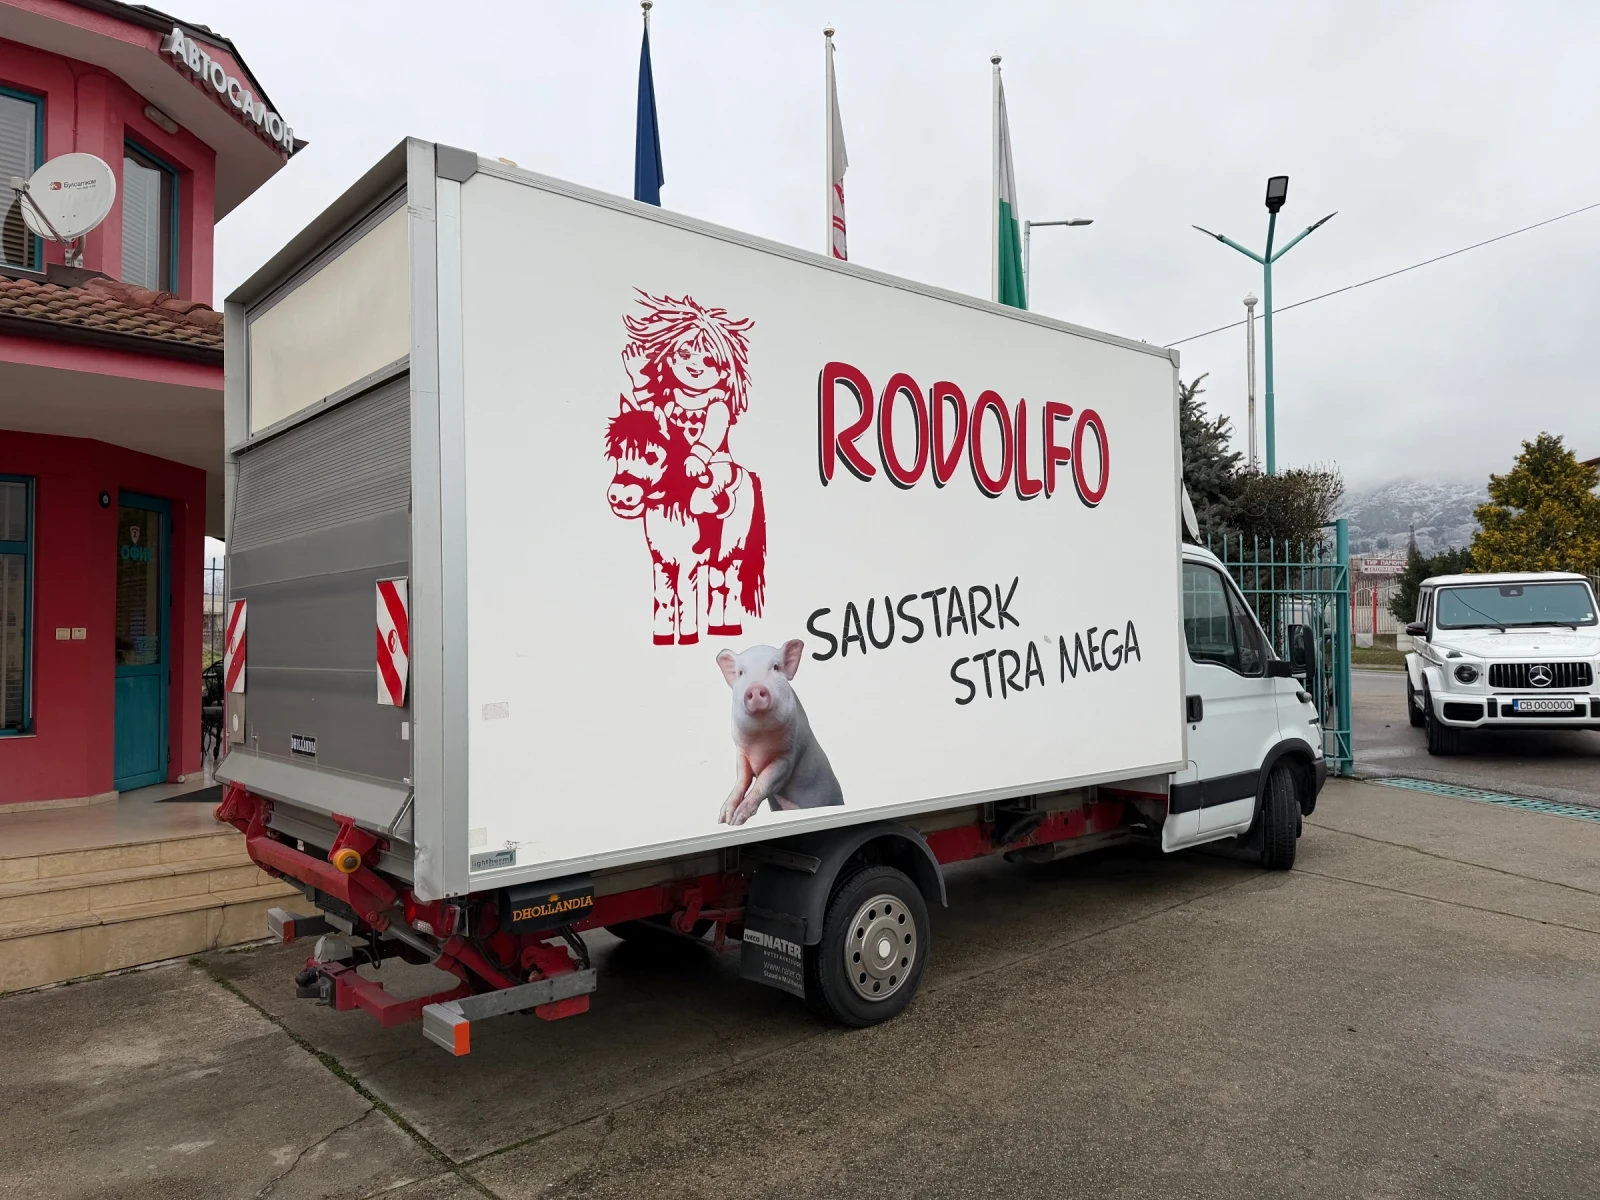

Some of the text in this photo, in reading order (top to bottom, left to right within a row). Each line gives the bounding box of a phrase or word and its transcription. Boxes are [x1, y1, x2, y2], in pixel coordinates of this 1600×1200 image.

[168, 28, 293, 154] АВТОСАЛОН
[818, 361, 1110, 509] RODOLFO
[806, 576, 1020, 661] SAUSTARK
[950, 620, 1141, 705] STRA MEGA
[513, 896, 593, 922] DHOLLANDIA
[744, 933, 802, 960] IVECO NATER
